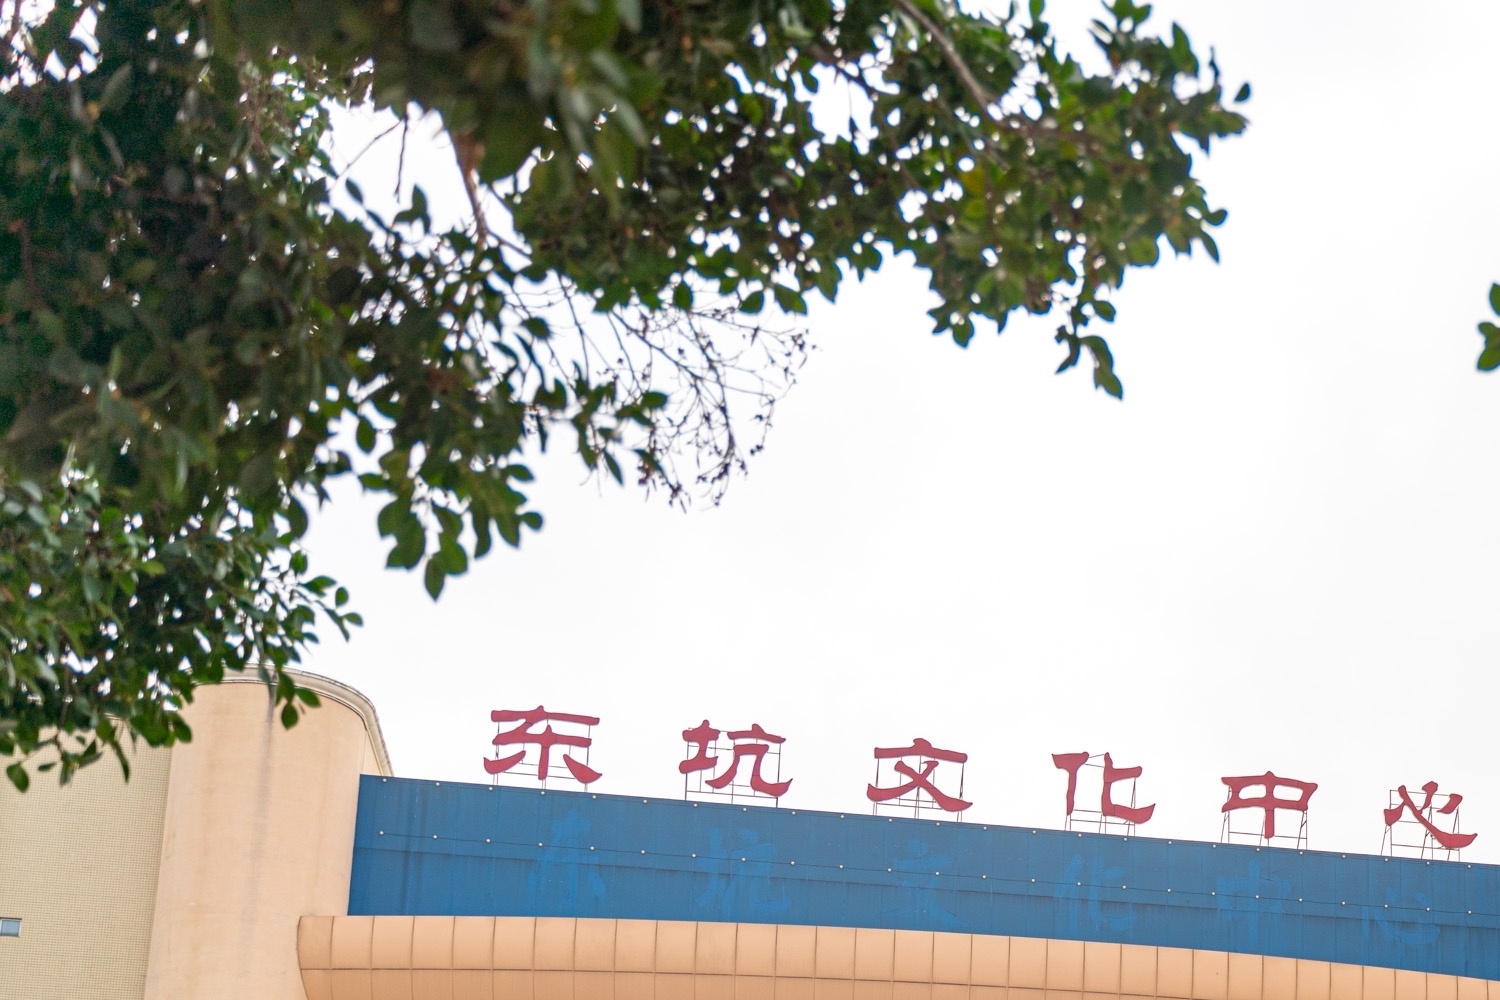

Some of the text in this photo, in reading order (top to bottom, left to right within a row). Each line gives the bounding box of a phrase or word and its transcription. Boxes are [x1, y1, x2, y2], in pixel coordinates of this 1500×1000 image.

[484, 706, 1478, 849] 东坑文化中心
